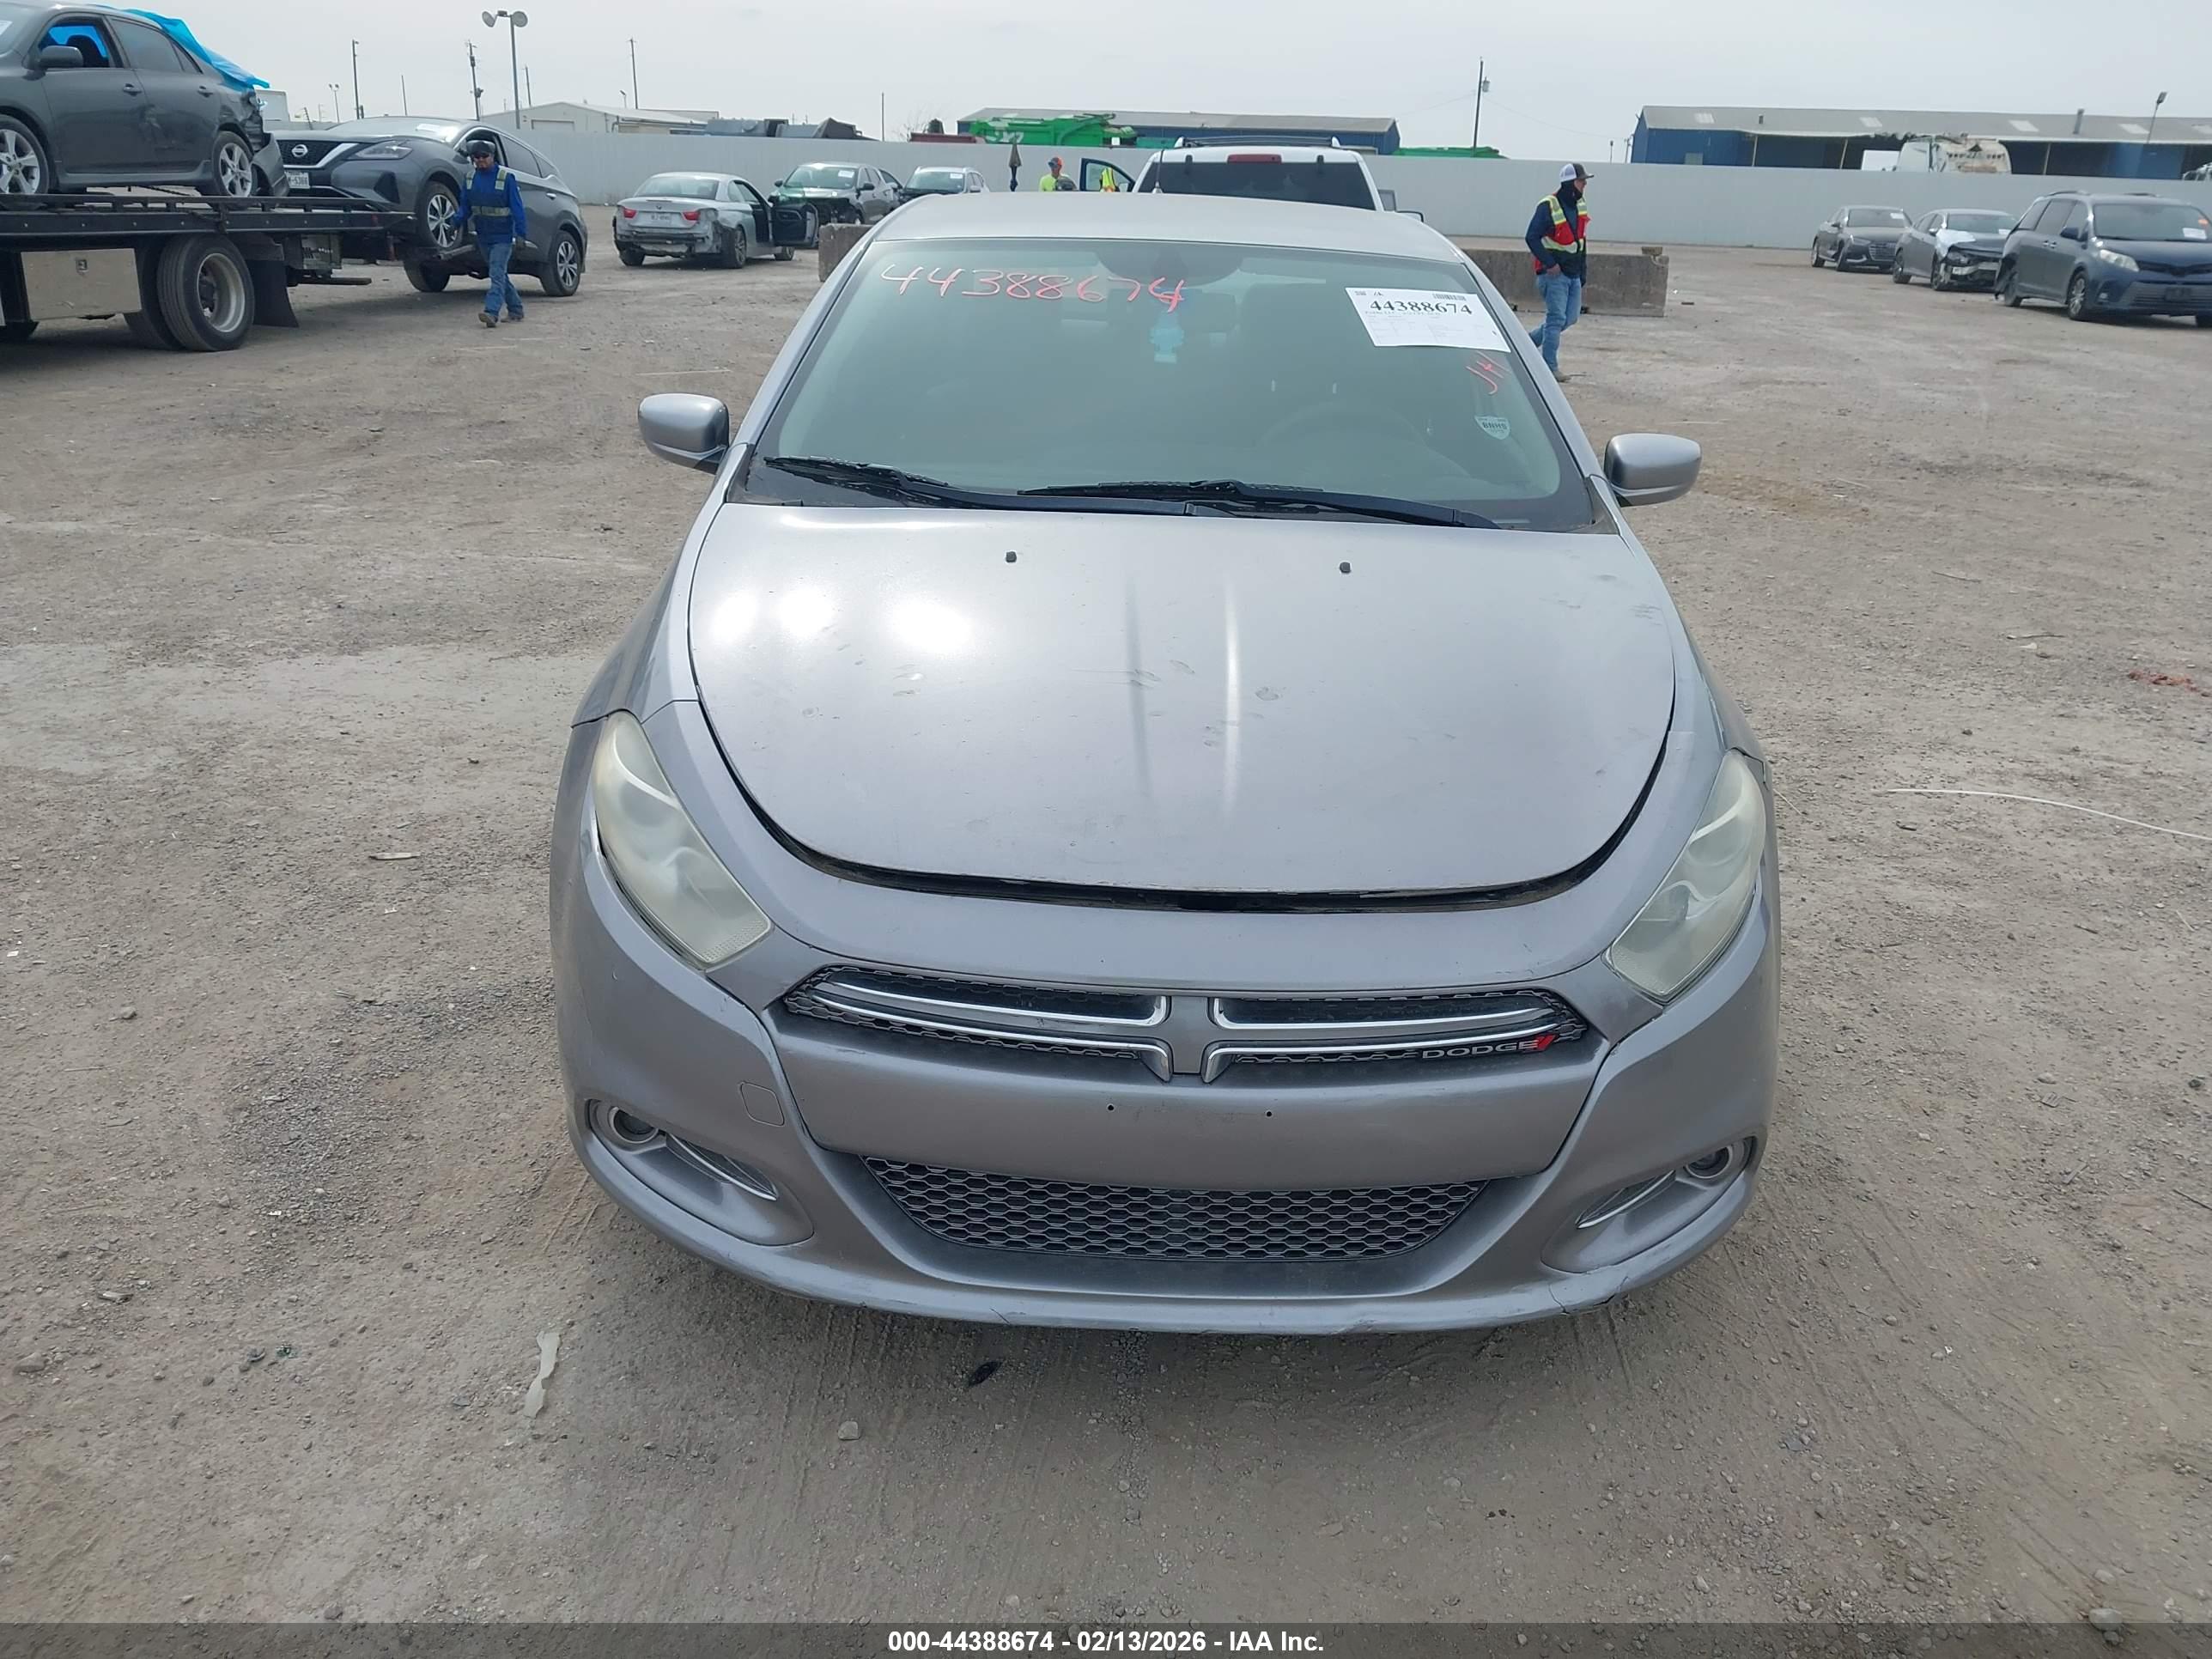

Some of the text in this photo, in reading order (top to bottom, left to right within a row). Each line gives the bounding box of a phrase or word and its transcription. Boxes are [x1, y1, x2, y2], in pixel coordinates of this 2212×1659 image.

[880, 264, 1184, 313] 44388674
[1370, 301, 1473, 315] 44388674
[1422, 1039, 1540, 1059] DODGE
